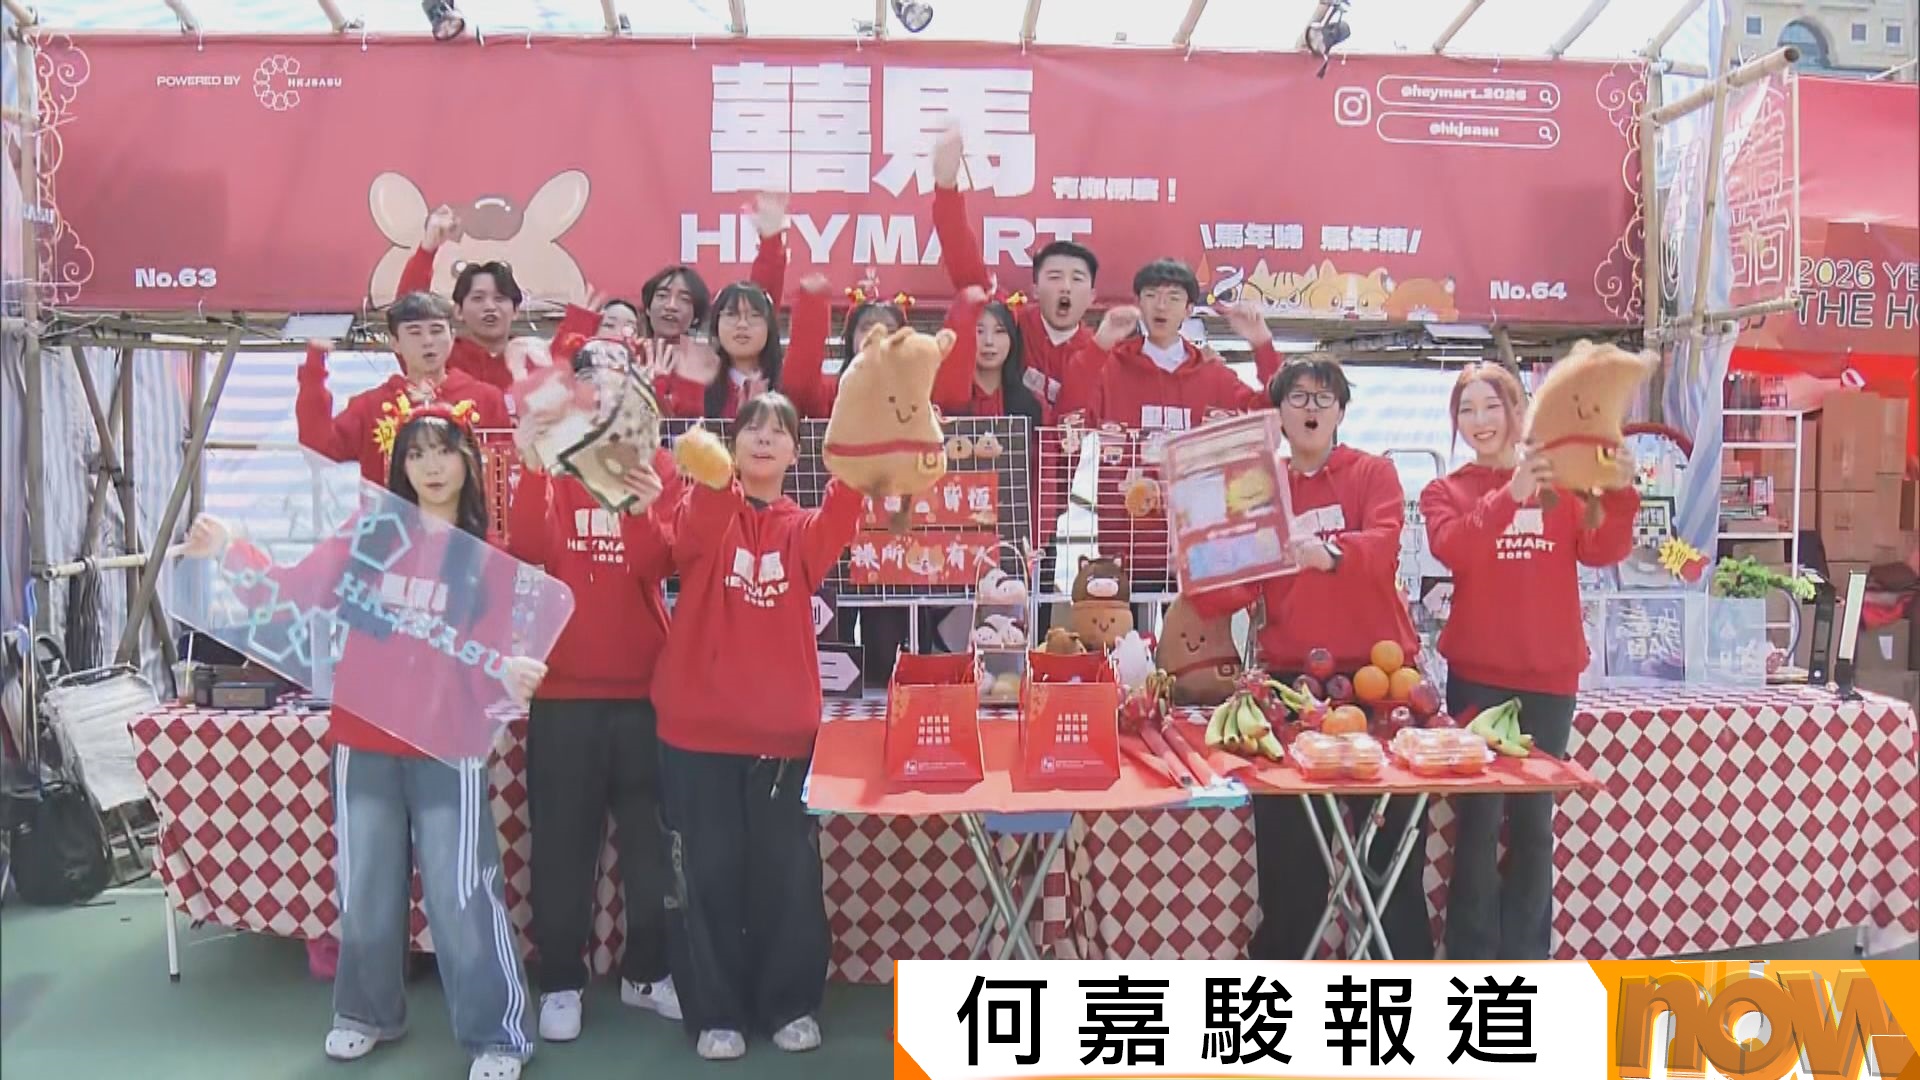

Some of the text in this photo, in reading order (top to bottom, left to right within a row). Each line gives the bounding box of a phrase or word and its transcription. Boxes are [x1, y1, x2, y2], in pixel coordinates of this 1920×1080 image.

[156, 75, 241, 87] POWERED BY
[287, 77, 343, 88] HKJSASU
[1429, 121, 1500, 138] @hkjsasu
[134, 267, 218, 288] No.63
[1799, 256, 1876, 289] 2026
[1490, 280, 1568, 301] No.64
[1797, 289, 1877, 327] THE
